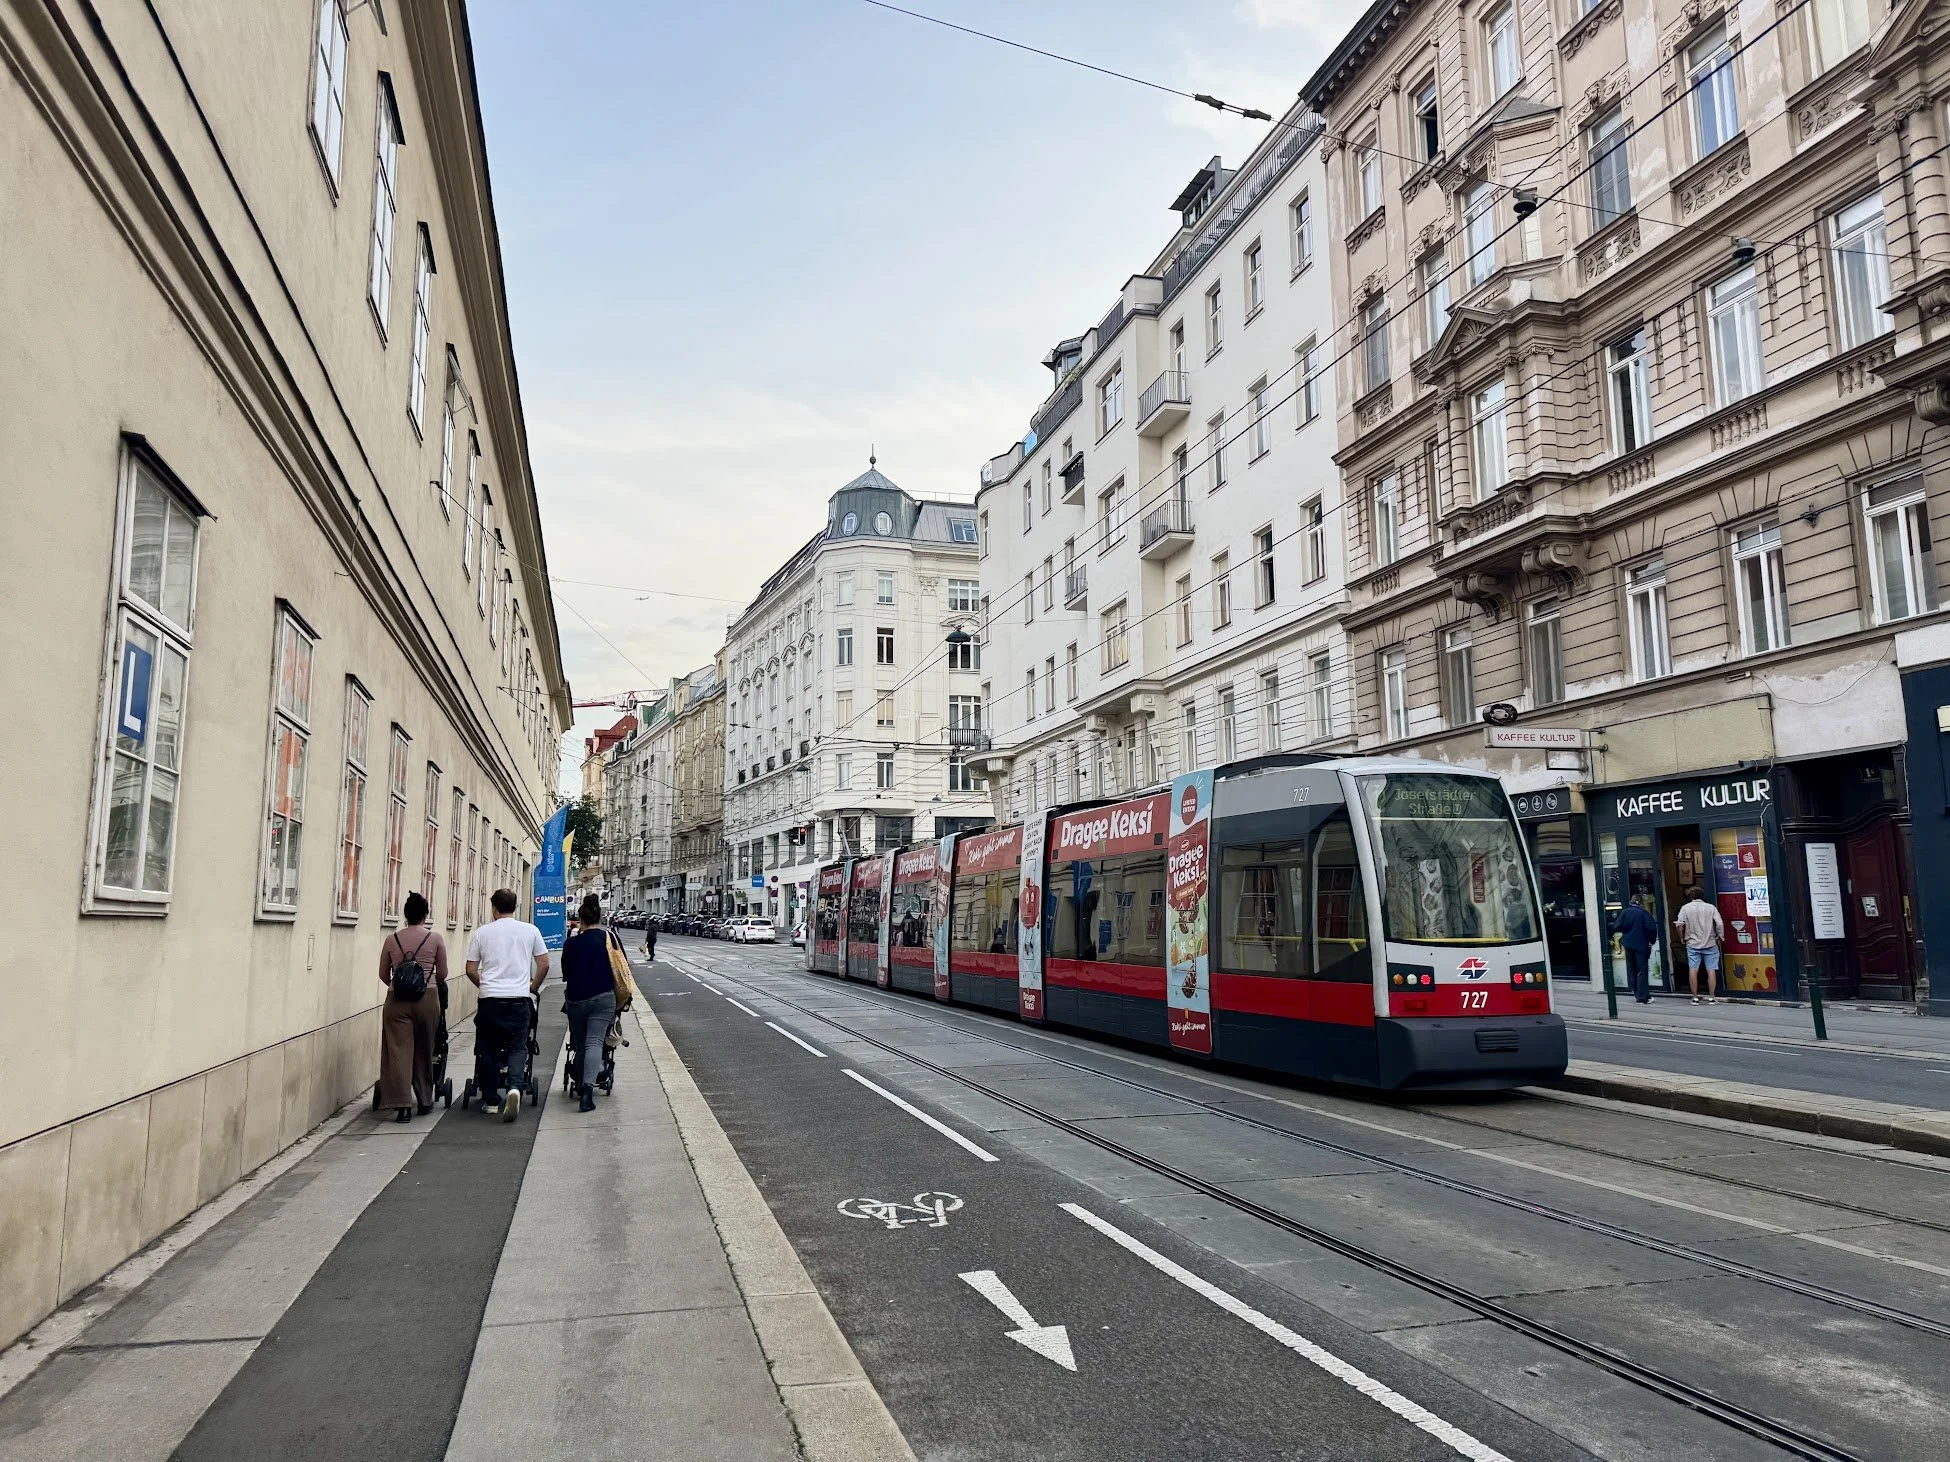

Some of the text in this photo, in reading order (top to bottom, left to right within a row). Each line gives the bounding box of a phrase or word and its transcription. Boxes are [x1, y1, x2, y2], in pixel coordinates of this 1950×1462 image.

[1497, 733, 1576, 742] KAFFEE KULTUR
[1293, 786, 1310, 802] 727
[1394, 789, 1477, 801] Josefstädter
[1617, 778, 1771, 818] KAFFEE KULTUR
[1409, 803, 1451, 815] Straße
[1060, 800, 1154, 850] Dragee Keksi
[899, 858, 920, 877] Dragee
[1169, 844, 1204, 874] Dragee
[1173, 860, 1200, 889] Keksi
[535, 895, 565, 904] CAMPUS
[1748, 888, 1767, 901] JAZZ
[1461, 991, 1488, 1009] 727
